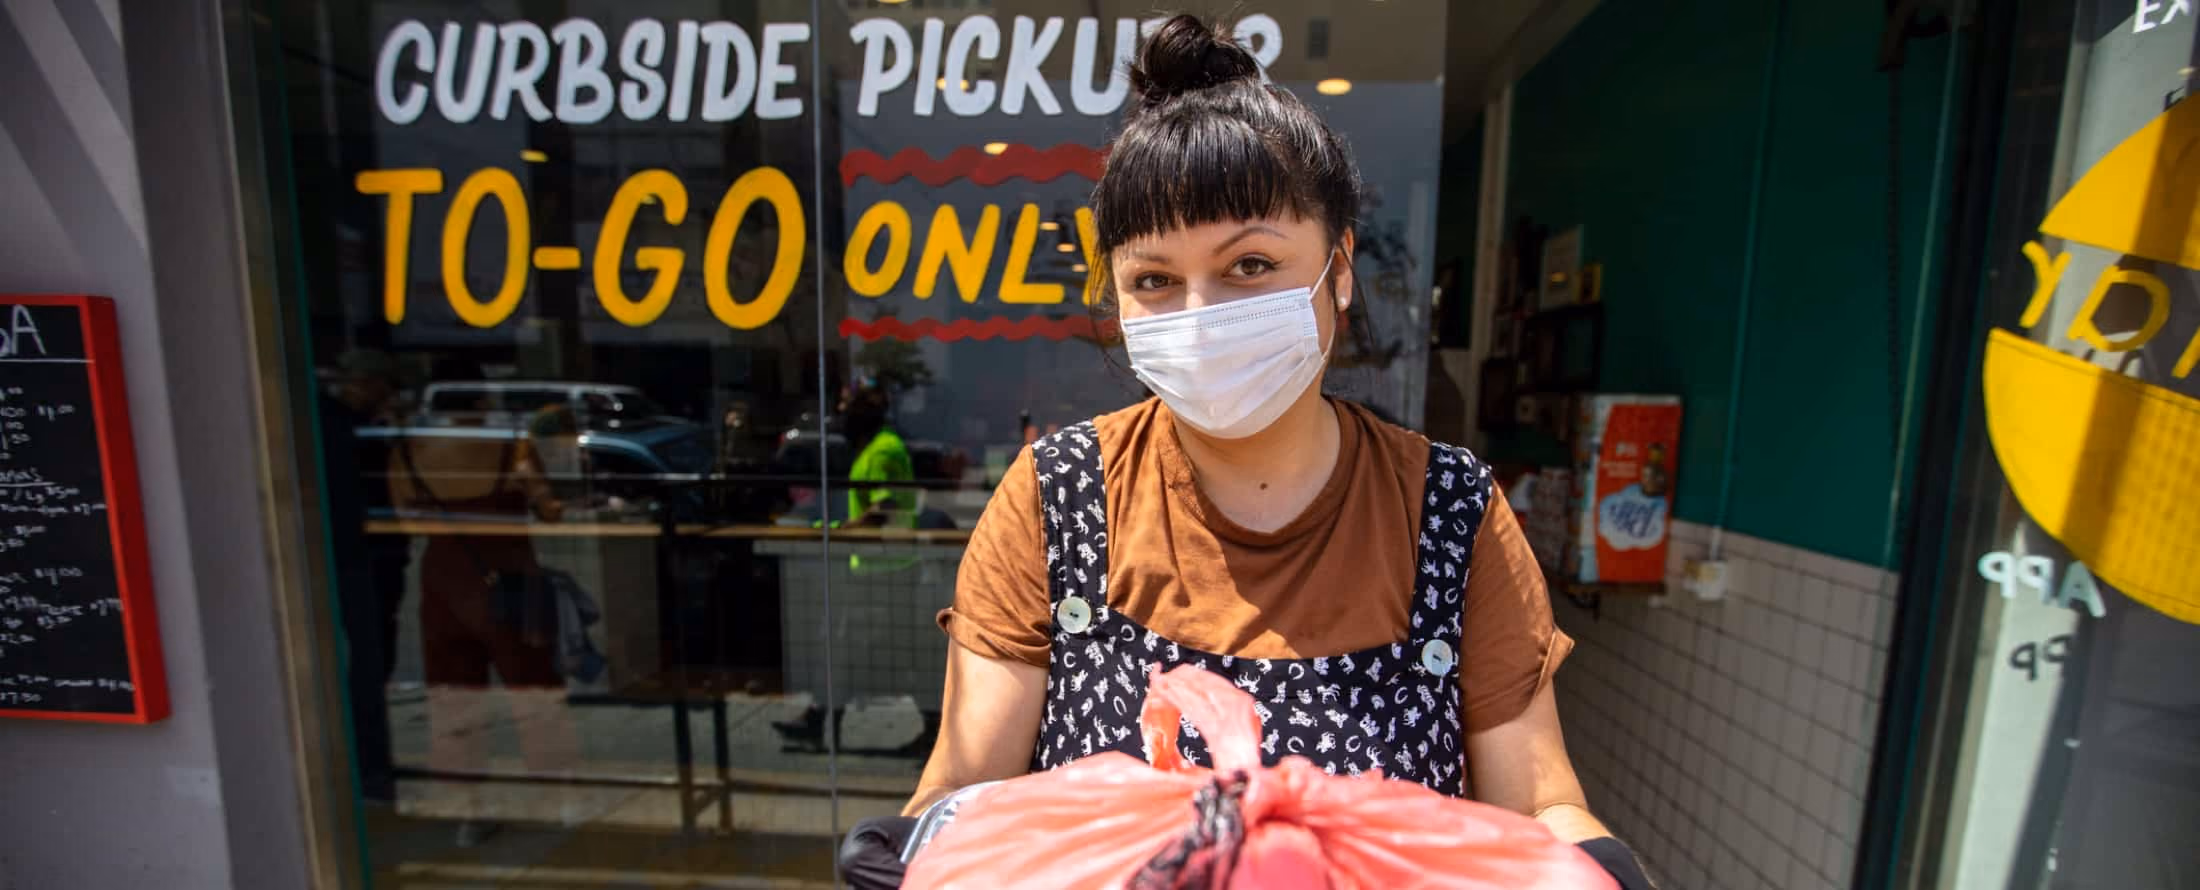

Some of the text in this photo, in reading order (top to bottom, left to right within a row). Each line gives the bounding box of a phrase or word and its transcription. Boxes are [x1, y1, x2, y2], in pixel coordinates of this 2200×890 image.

[376, 18, 810, 124] CURBSIDE
[849, 15, 1170, 117] PICKU
[355, 167, 806, 330] TO-GO
